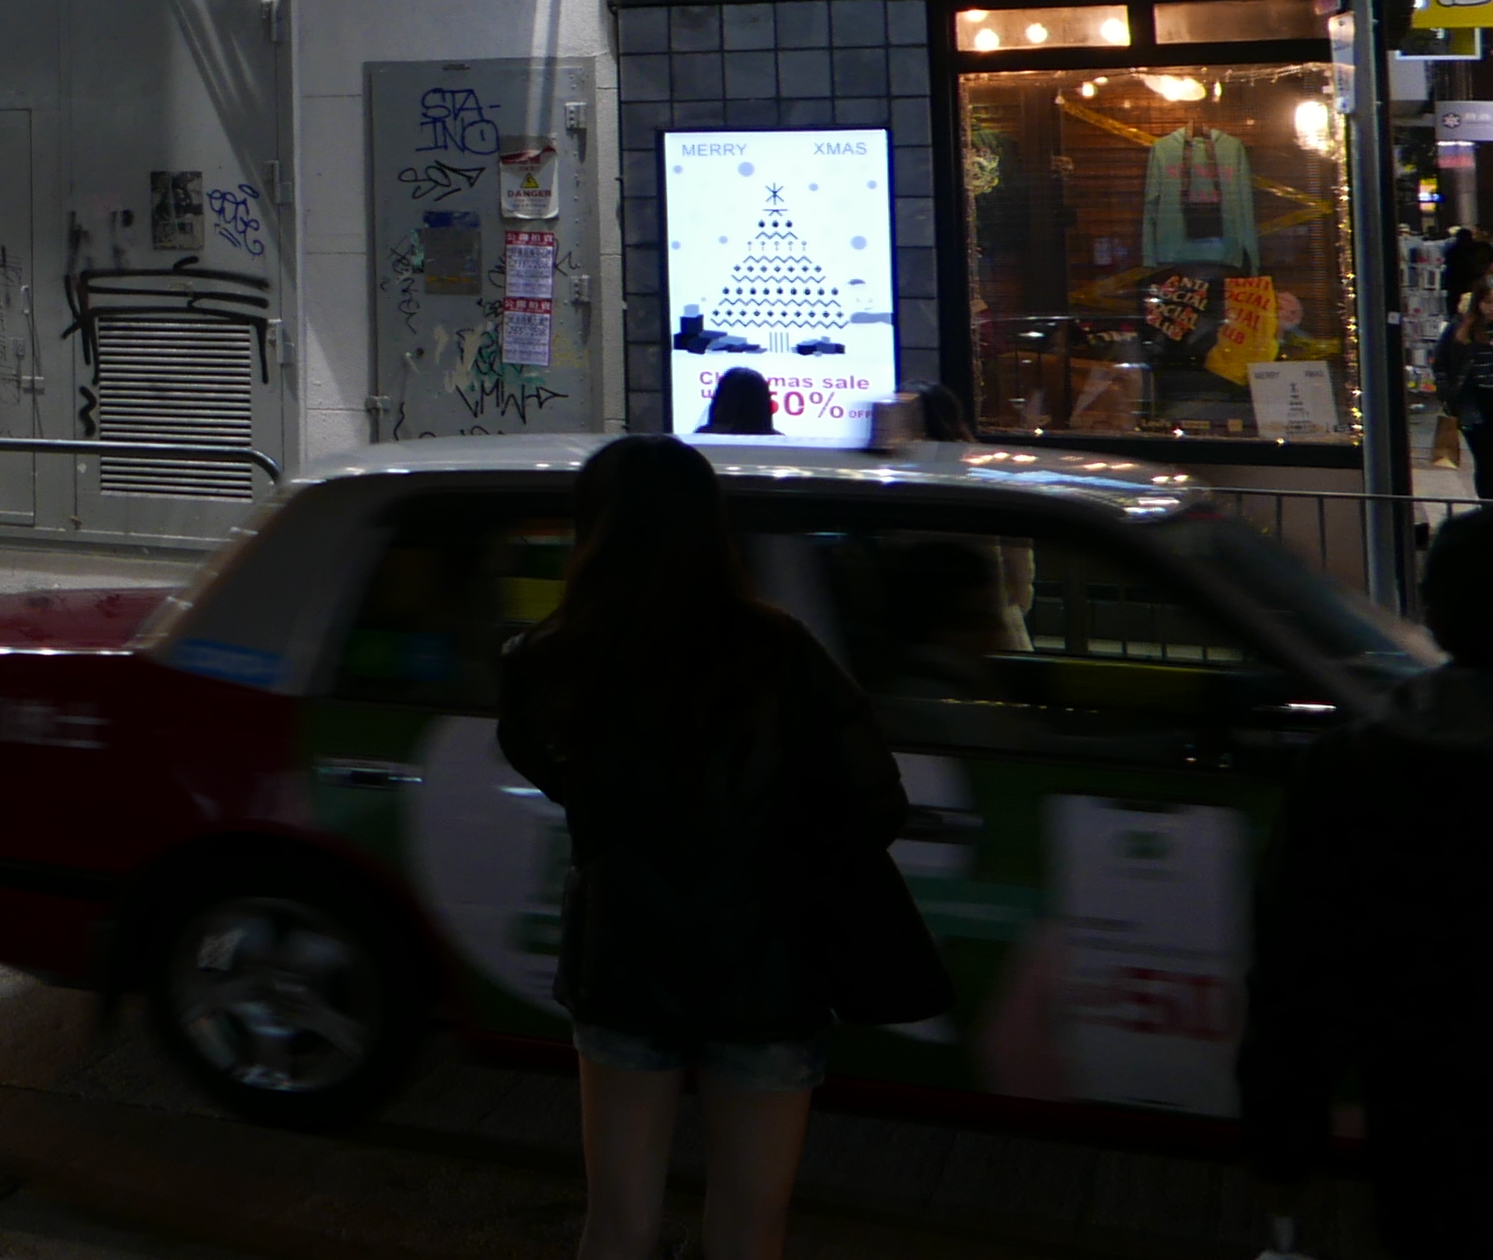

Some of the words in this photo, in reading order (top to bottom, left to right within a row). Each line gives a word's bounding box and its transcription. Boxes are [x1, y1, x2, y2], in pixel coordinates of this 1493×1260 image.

[682, 143, 747, 156] MERRY
[814, 142, 867, 156] XMAS
[507, 190, 551, 198] DANGER
[700, 371, 813, 389] Chmas
[822, 374, 870, 390] sale
